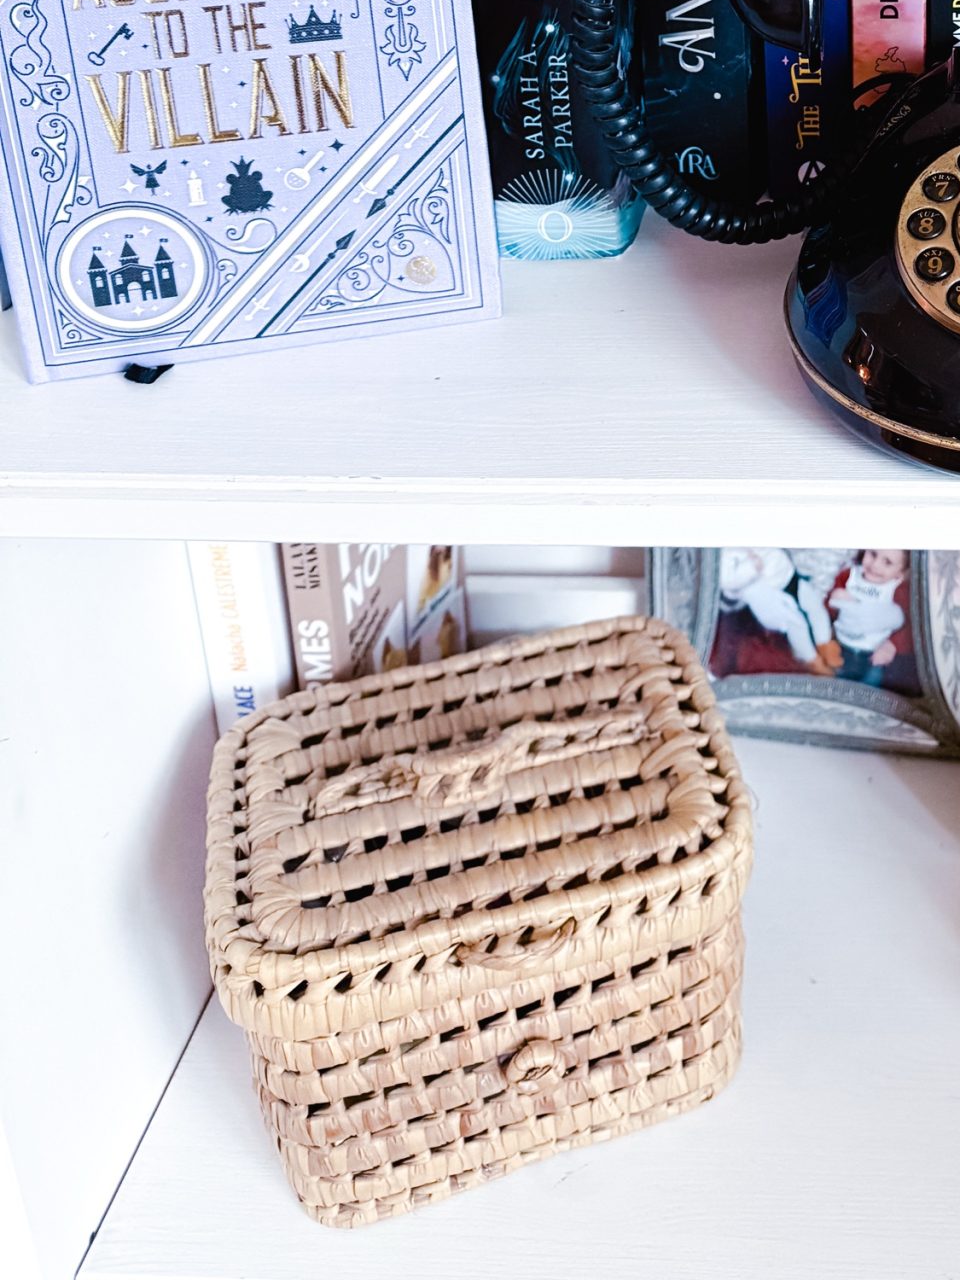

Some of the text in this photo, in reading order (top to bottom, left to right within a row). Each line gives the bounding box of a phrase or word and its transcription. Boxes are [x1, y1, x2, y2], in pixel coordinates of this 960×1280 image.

[139, 1, 273, 61] TO THE
[84, 50, 358, 154] VILLAIN
[518, 42, 546, 159] SARAH A.
[547, 52, 574, 150] PARKER
[794, 104, 821, 150] THE
[935, 182, 949, 198] 7
[918, 218, 933, 234] 8
[927, 257, 943, 274] 9
[225, 623, 248, 672] Natacha
